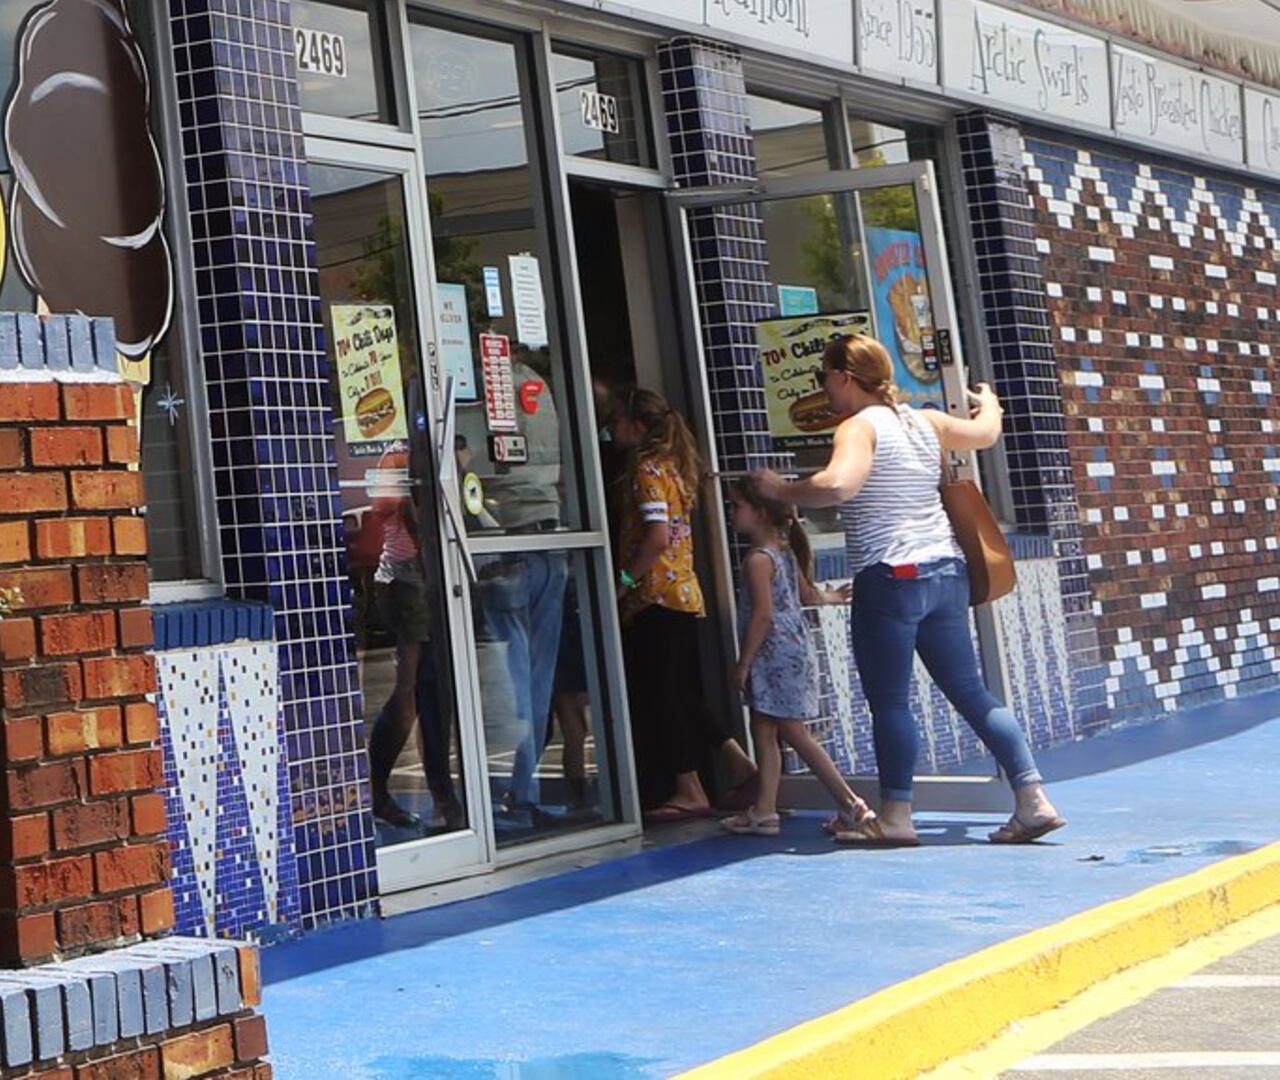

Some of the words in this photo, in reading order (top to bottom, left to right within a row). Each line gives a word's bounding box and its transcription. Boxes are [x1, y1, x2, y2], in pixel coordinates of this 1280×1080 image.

[296, 31, 345, 76] 2469
[968, 5, 1027, 95] Arctic
[1033, 27, 1090, 112] Swirls
[582, 91, 618, 133] 2469
